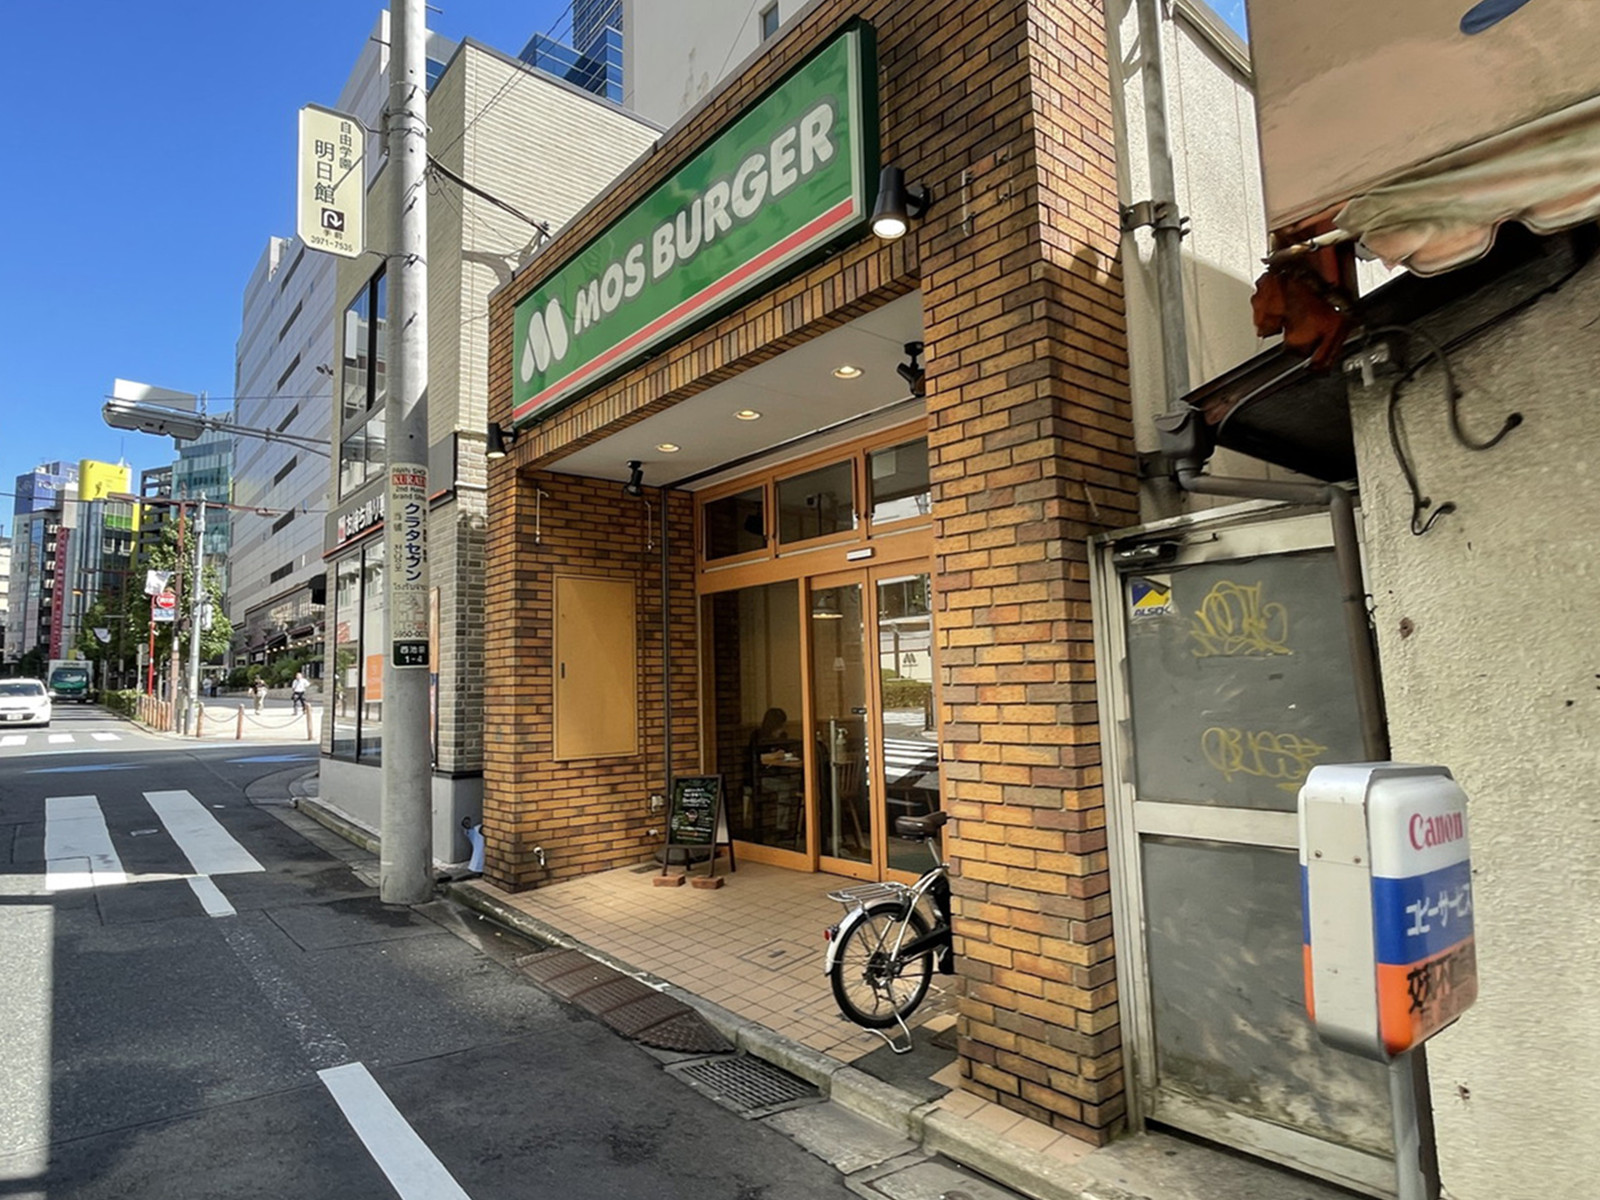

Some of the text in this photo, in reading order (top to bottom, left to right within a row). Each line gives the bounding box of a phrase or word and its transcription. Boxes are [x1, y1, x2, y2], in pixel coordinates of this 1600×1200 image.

[314, 139, 335, 205] 明日館
[574, 103, 835, 335] MOS BURGER
[1408, 811, 1463, 851] Canon
